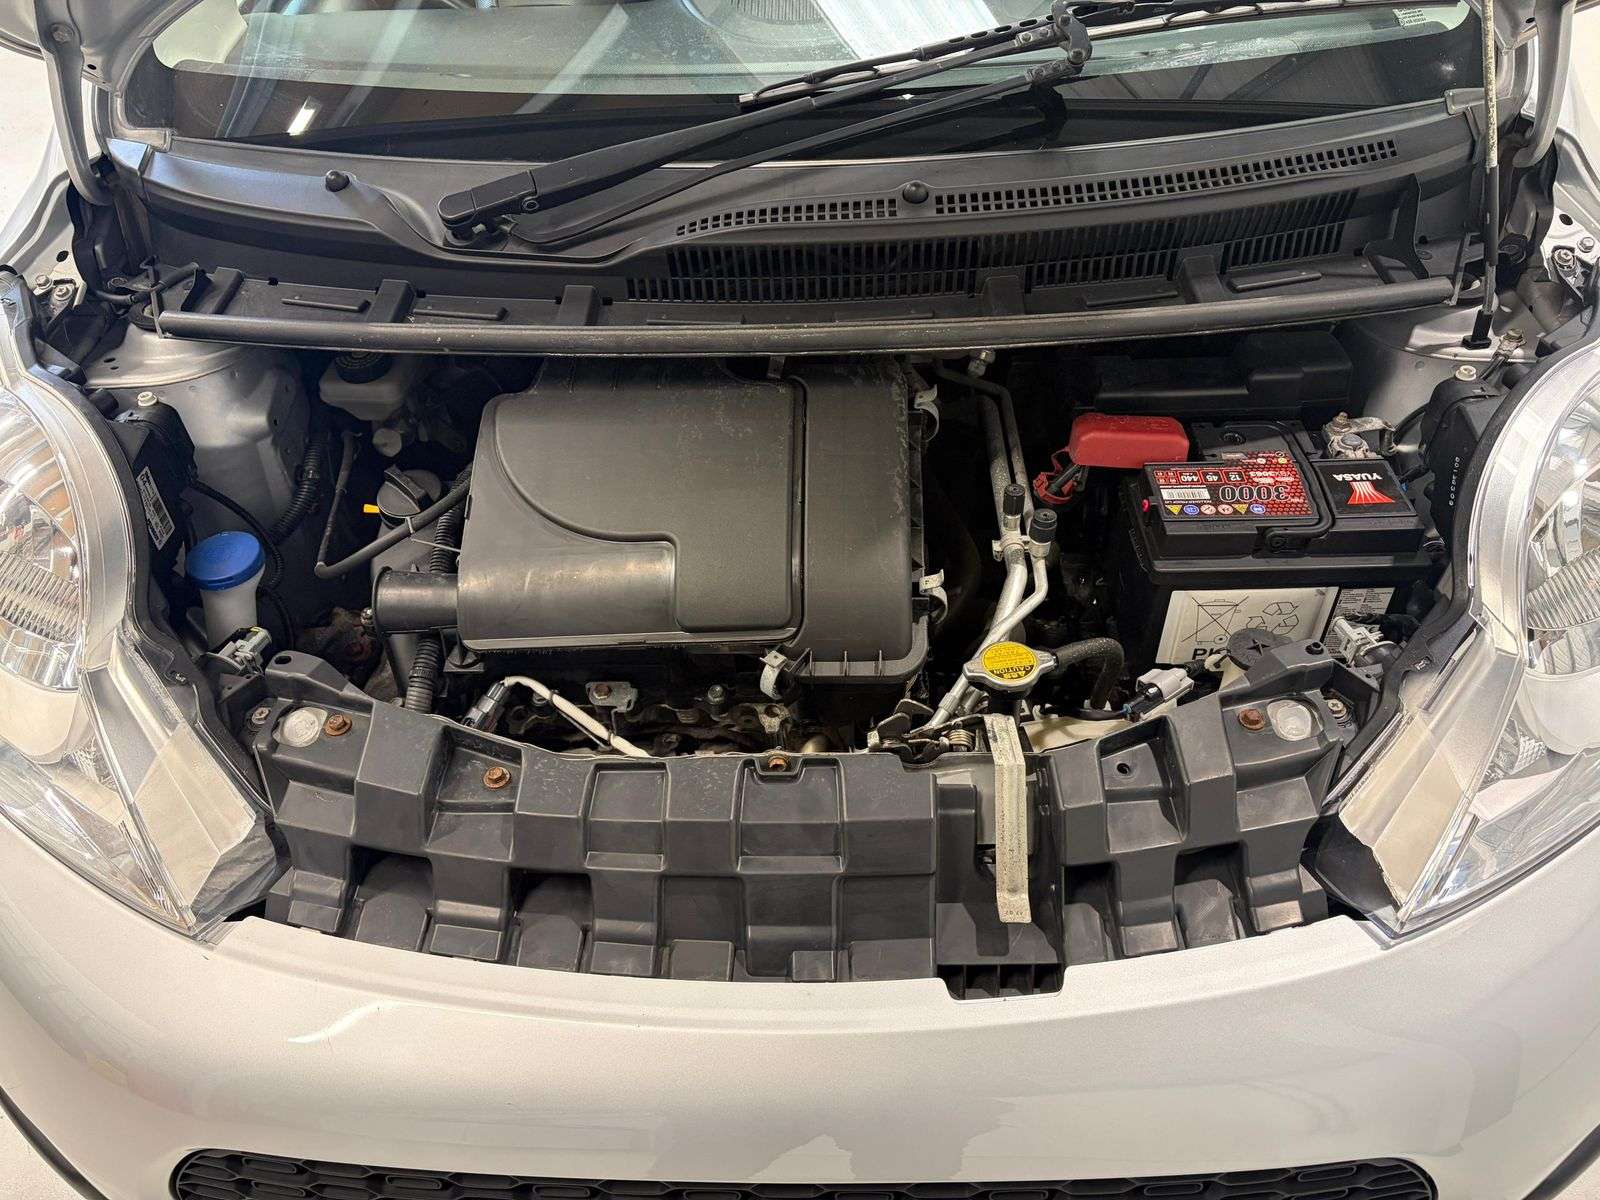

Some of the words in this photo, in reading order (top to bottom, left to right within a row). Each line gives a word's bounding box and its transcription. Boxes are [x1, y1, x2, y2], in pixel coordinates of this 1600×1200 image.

[1180, 473, 1199, 482] 440
[1206, 473, 1219, 481] 45
[1228, 473, 1242, 481] 12
[1332, 471, 1383, 482] YUASA
[1219, 485, 1290, 502] 3000
[993, 664, 1032, 674] CAUTION
